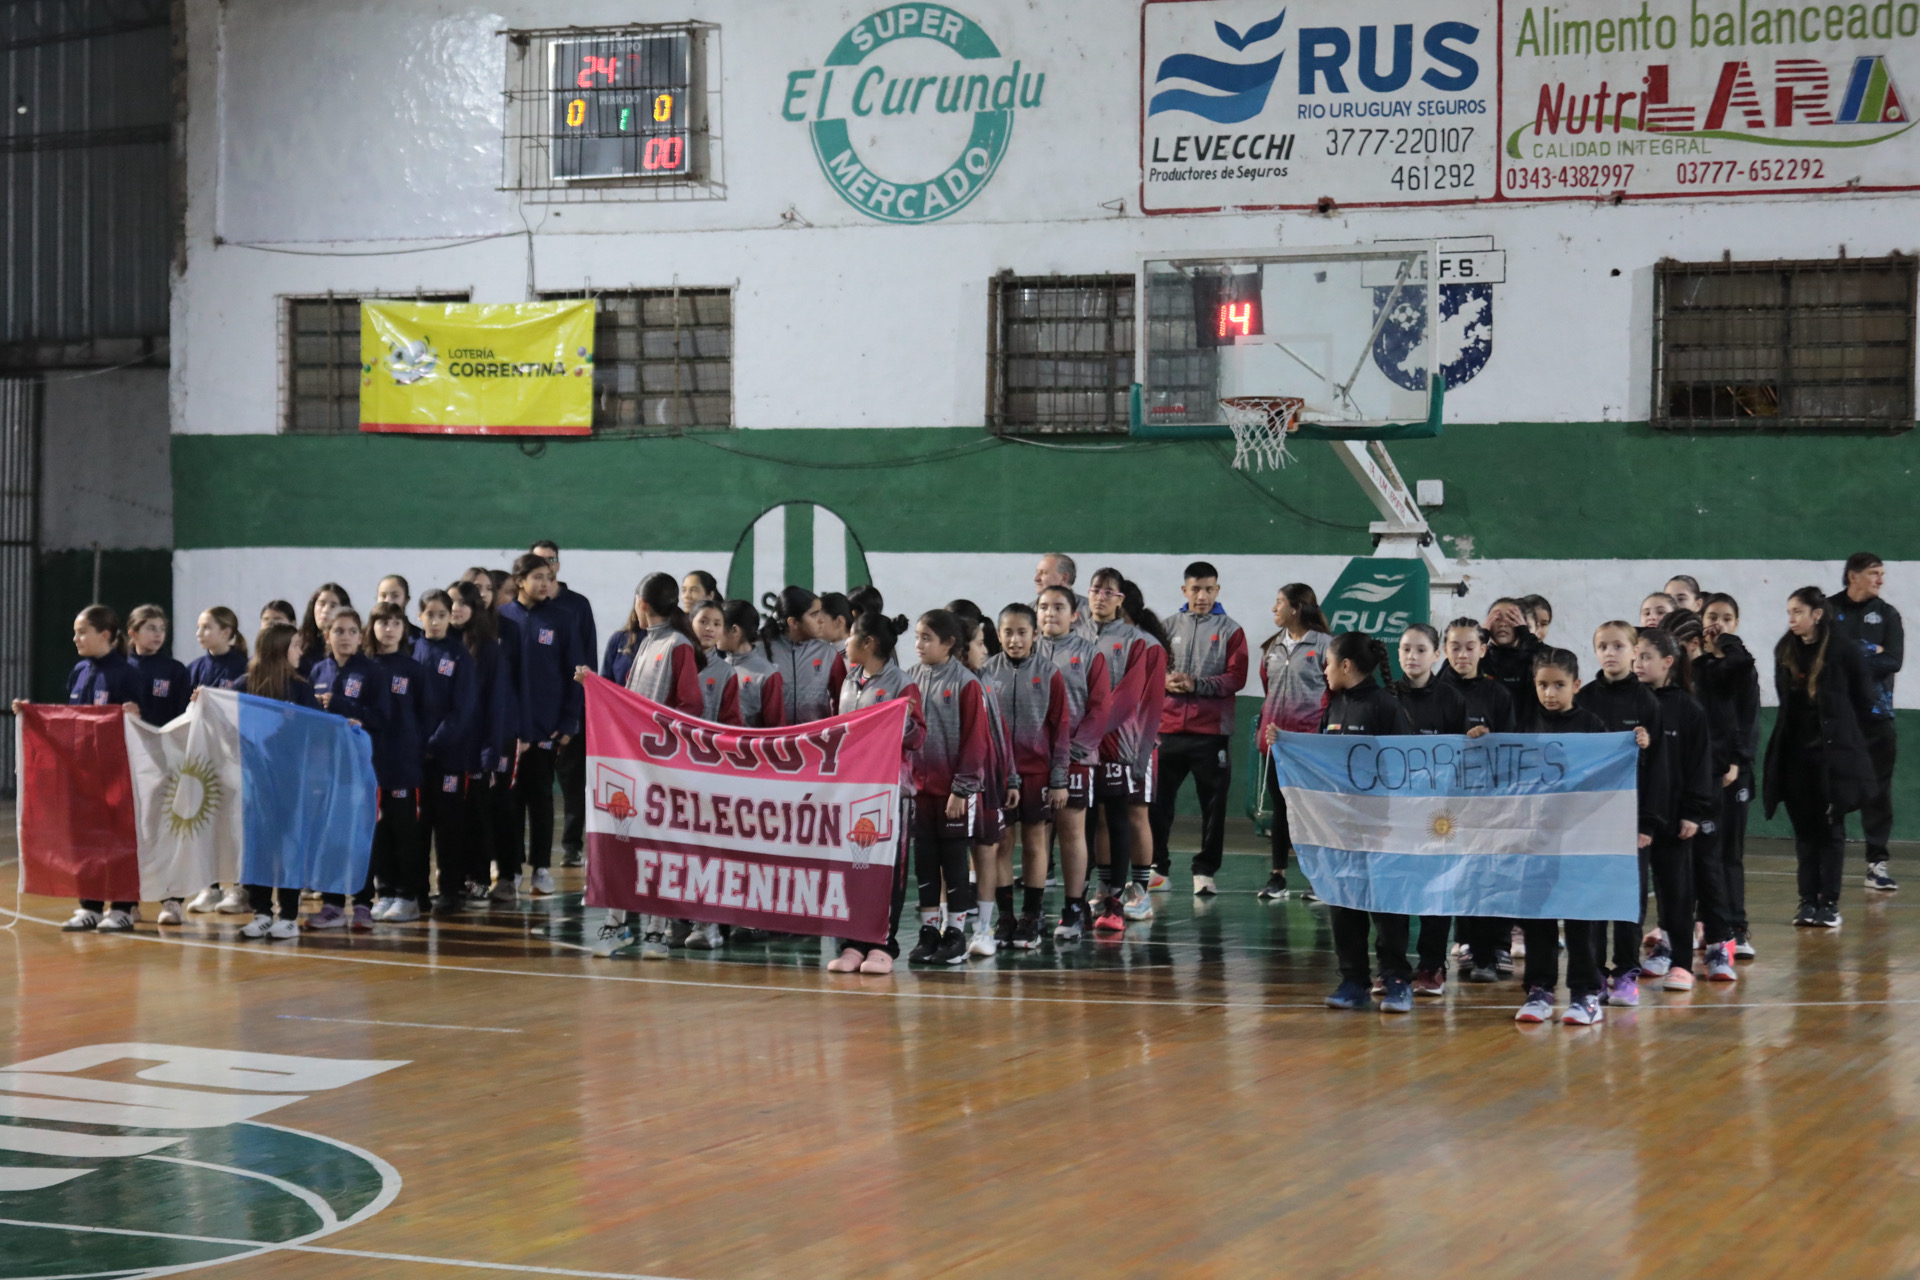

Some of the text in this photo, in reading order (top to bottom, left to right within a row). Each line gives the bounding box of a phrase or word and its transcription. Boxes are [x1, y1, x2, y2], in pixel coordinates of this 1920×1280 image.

[851, 8, 963, 51] SUPER
[1515, 0, 1919, 57] Alimento balanceado
[1298, 21, 1480, 95] RUS
[781, 60, 1046, 122] El Curundu
[566, 99, 587, 127] 0
[653, 94, 673, 122] 0
[1298, 99, 1487, 119] RIO URUGUAY SEGUROS
[1152, 134, 1295, 163] LEVECCHI
[1326, 127, 1475, 156] 3777-220107
[1533, 137, 1712, 158] CALIDAD INTEGRAL
[829, 147, 989, 217] MERCADO
[1149, 165, 1288, 183] Productores de Seguros
[1391, 164, 1476, 191] 461292
[1506, 159, 1824, 190] 0343-4382997 03777-652292
[1219, 302, 1251, 337] 14
[448, 346, 495, 360] LOTERÍA
[448, 361, 567, 378] CORRENTINA
[1330, 610, 1410, 634] RUS
[640, 712, 849, 776] JUJUY
[1069, 773, 1083, 790] 11
[1105, 763, 1122, 778] 13
[644, 783, 843, 849] SELECCIÓN
[634, 848, 850, 922] FEMENINA
